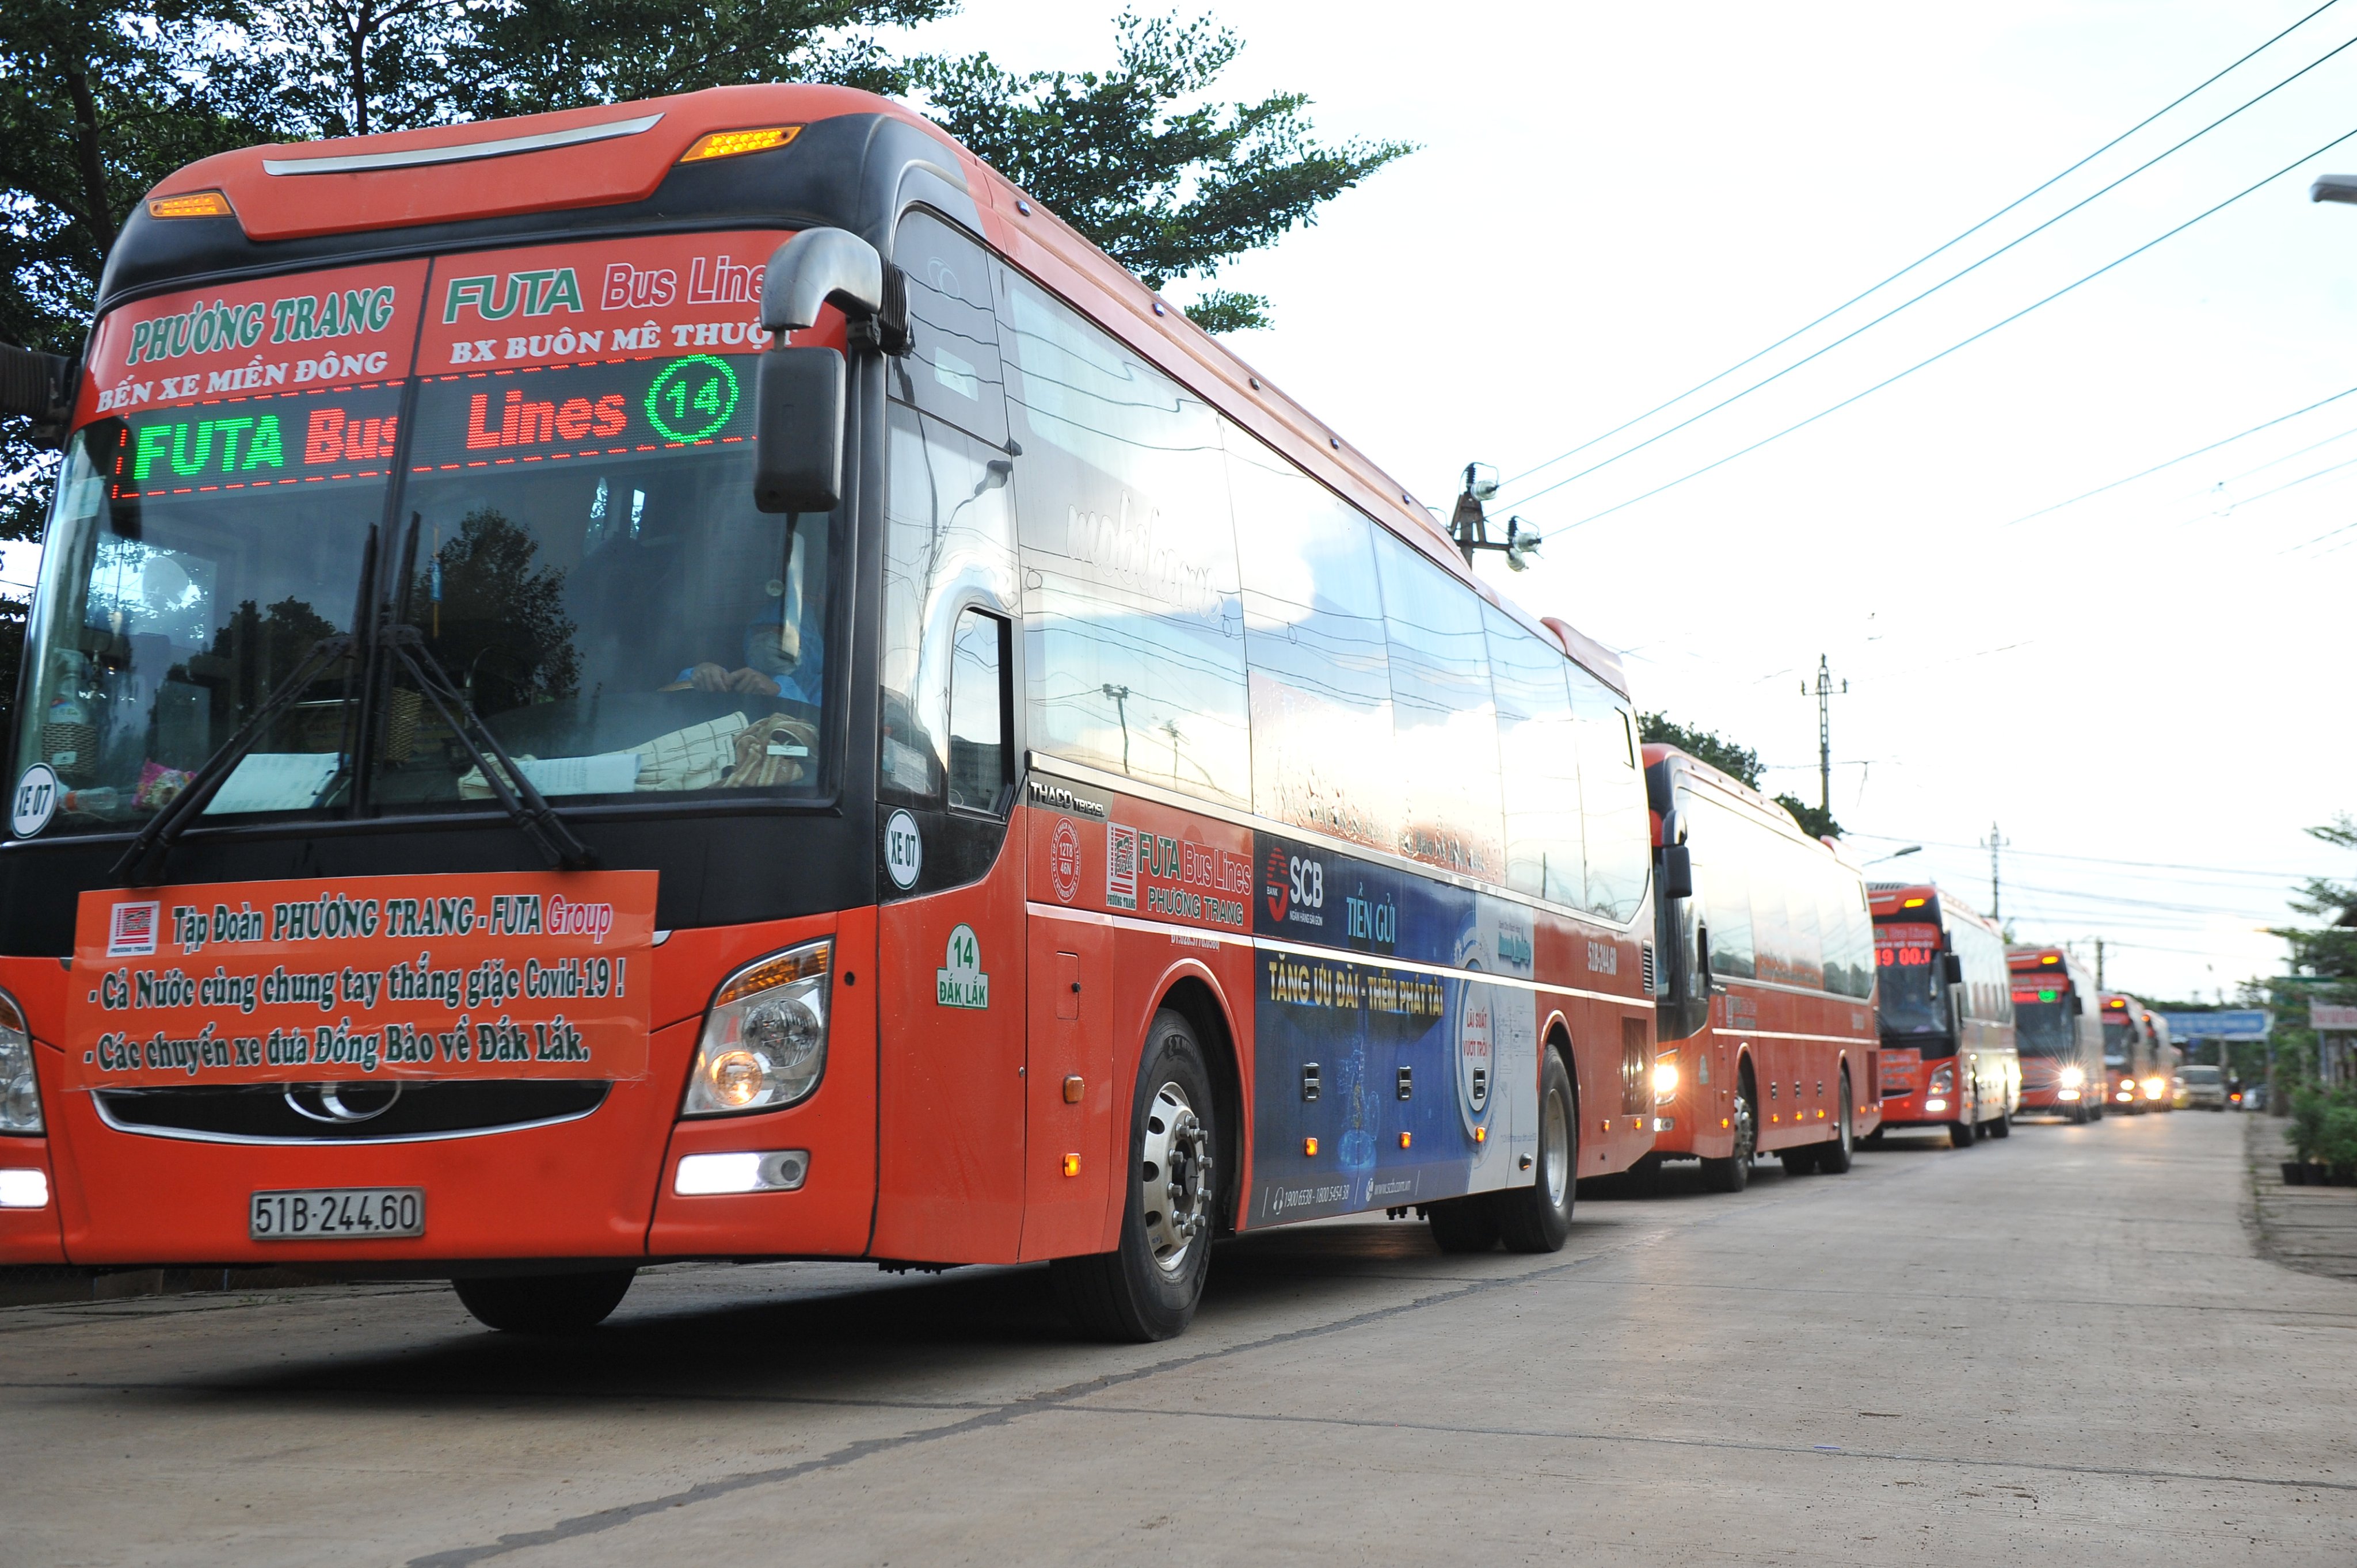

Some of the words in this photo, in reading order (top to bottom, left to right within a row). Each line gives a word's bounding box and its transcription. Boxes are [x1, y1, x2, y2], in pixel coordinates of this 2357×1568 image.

[442, 267, 584, 325] FUTA
[600, 262, 677, 311] Bus
[687, 255, 767, 305] Line
[125, 299, 264, 365] PHƯƠNG
[271, 285, 395, 344] TRANG
[450, 339, 497, 364] BX
[504, 326, 603, 360] BUÔN
[610, 320, 661, 351] MÊ
[95, 369, 153, 413] BẾN
[157, 373, 200, 400] XE
[205, 354, 288, 394] MIỀN
[294, 350, 388, 383] ĐÔNG
[665, 377, 721, 418] 14
[134, 414, 284, 479] FUTA
[304, 408, 398, 464] Bus
[466, 390, 628, 450] Lines
[14, 785, 33, 818] XE
[33, 784, 52, 816] 07
[1030, 781, 1072, 808] THACO
[890, 830, 903, 866] XE
[905, 833, 916, 868] 07
[1059, 842, 1073, 857] 12T8
[1060, 861, 1072, 875] 46N
[1138, 831, 1181, 881] FUTA
[1183, 841, 1212, 888] Bus
[1214, 849, 1252, 896] Lines
[1266, 886, 1278, 896] BANK
[1289, 855, 1323, 909] SCB
[173, 905, 209, 955] Tập
[211, 902, 264, 943] Đoàn
[271, 892, 379, 941] PHƯƠNG
[547, 894, 613, 944] Group
[1148, 886, 1201, 920] PHƯƠNG
[1204, 897, 1243, 926] TRANG
[1346, 882, 1372, 940] TIỀN
[1375, 892, 1395, 943] GỬI
[954, 936, 973, 969] 14
[134, 968, 196, 1009] Nước
[199, 966, 258, 1014] cùng
[261, 965, 337, 1012] chung
[340, 966, 383, 1010] tay
[386, 951, 463, 1009] thắng
[466, 958, 521, 1008] giặc
[939, 973, 962, 1004] ĐẮK
[965, 975, 986, 1006] LẮK
[1269, 953, 1309, 1004] TĂNG
[1314, 963, 1331, 1006] ƯU
[1368, 968, 1397, 1012] THÊM
[1399, 973, 1426, 1015] PHÁT
[144, 1021, 231, 1076] chuyến
[233, 1037, 262, 1066] xe
[265, 1027, 310, 1065] đưa
[311, 1016, 381, 1073] Đồng
[438, 1013, 472, 1062] về
[475, 1014, 531, 1062] Đắk
[534, 1014, 591, 1063] Lắk.
[1284, 1189, 1297, 1207] 1900
[1316, 1187, 1328, 1204] 1800
